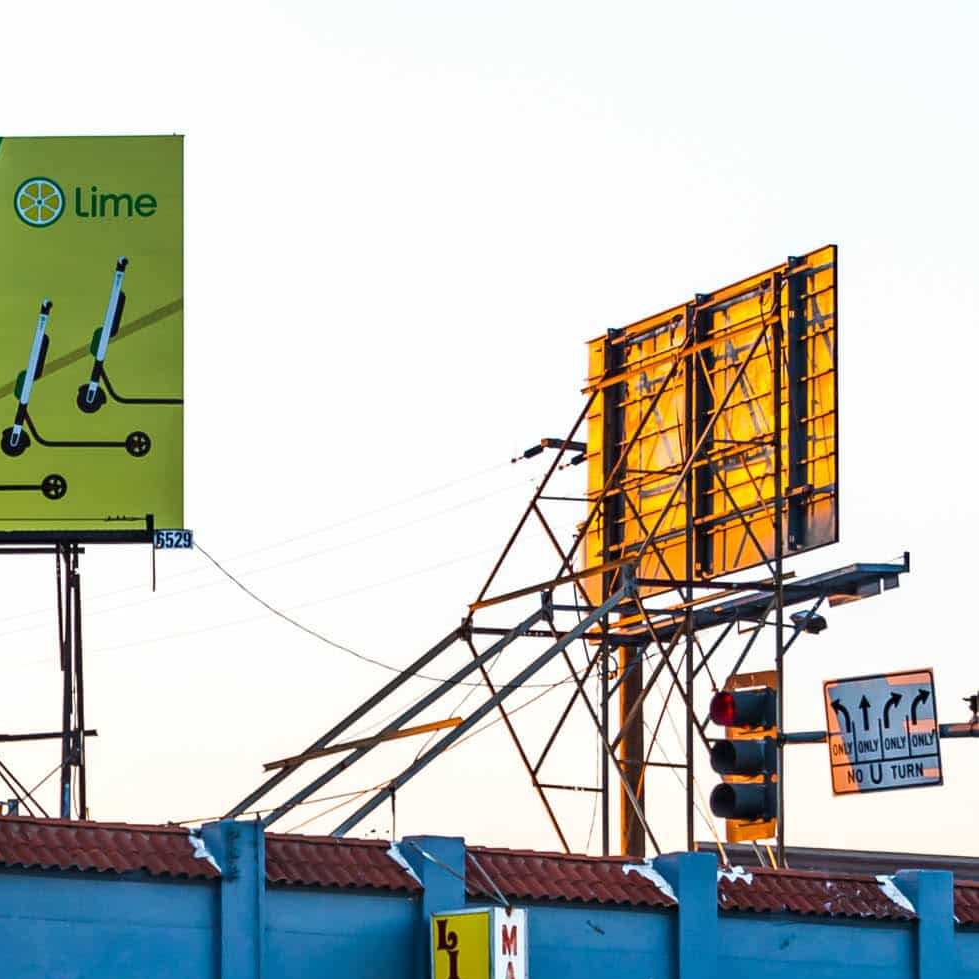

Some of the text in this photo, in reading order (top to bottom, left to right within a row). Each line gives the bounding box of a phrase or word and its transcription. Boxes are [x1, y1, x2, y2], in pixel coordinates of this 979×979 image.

[75, 186, 157, 217] Lime
[155, 531, 192, 548] 6529
[832, 733, 935, 756] ONLY ONLY ONLY ONLY
[847, 763, 924, 784] NO U TURN
